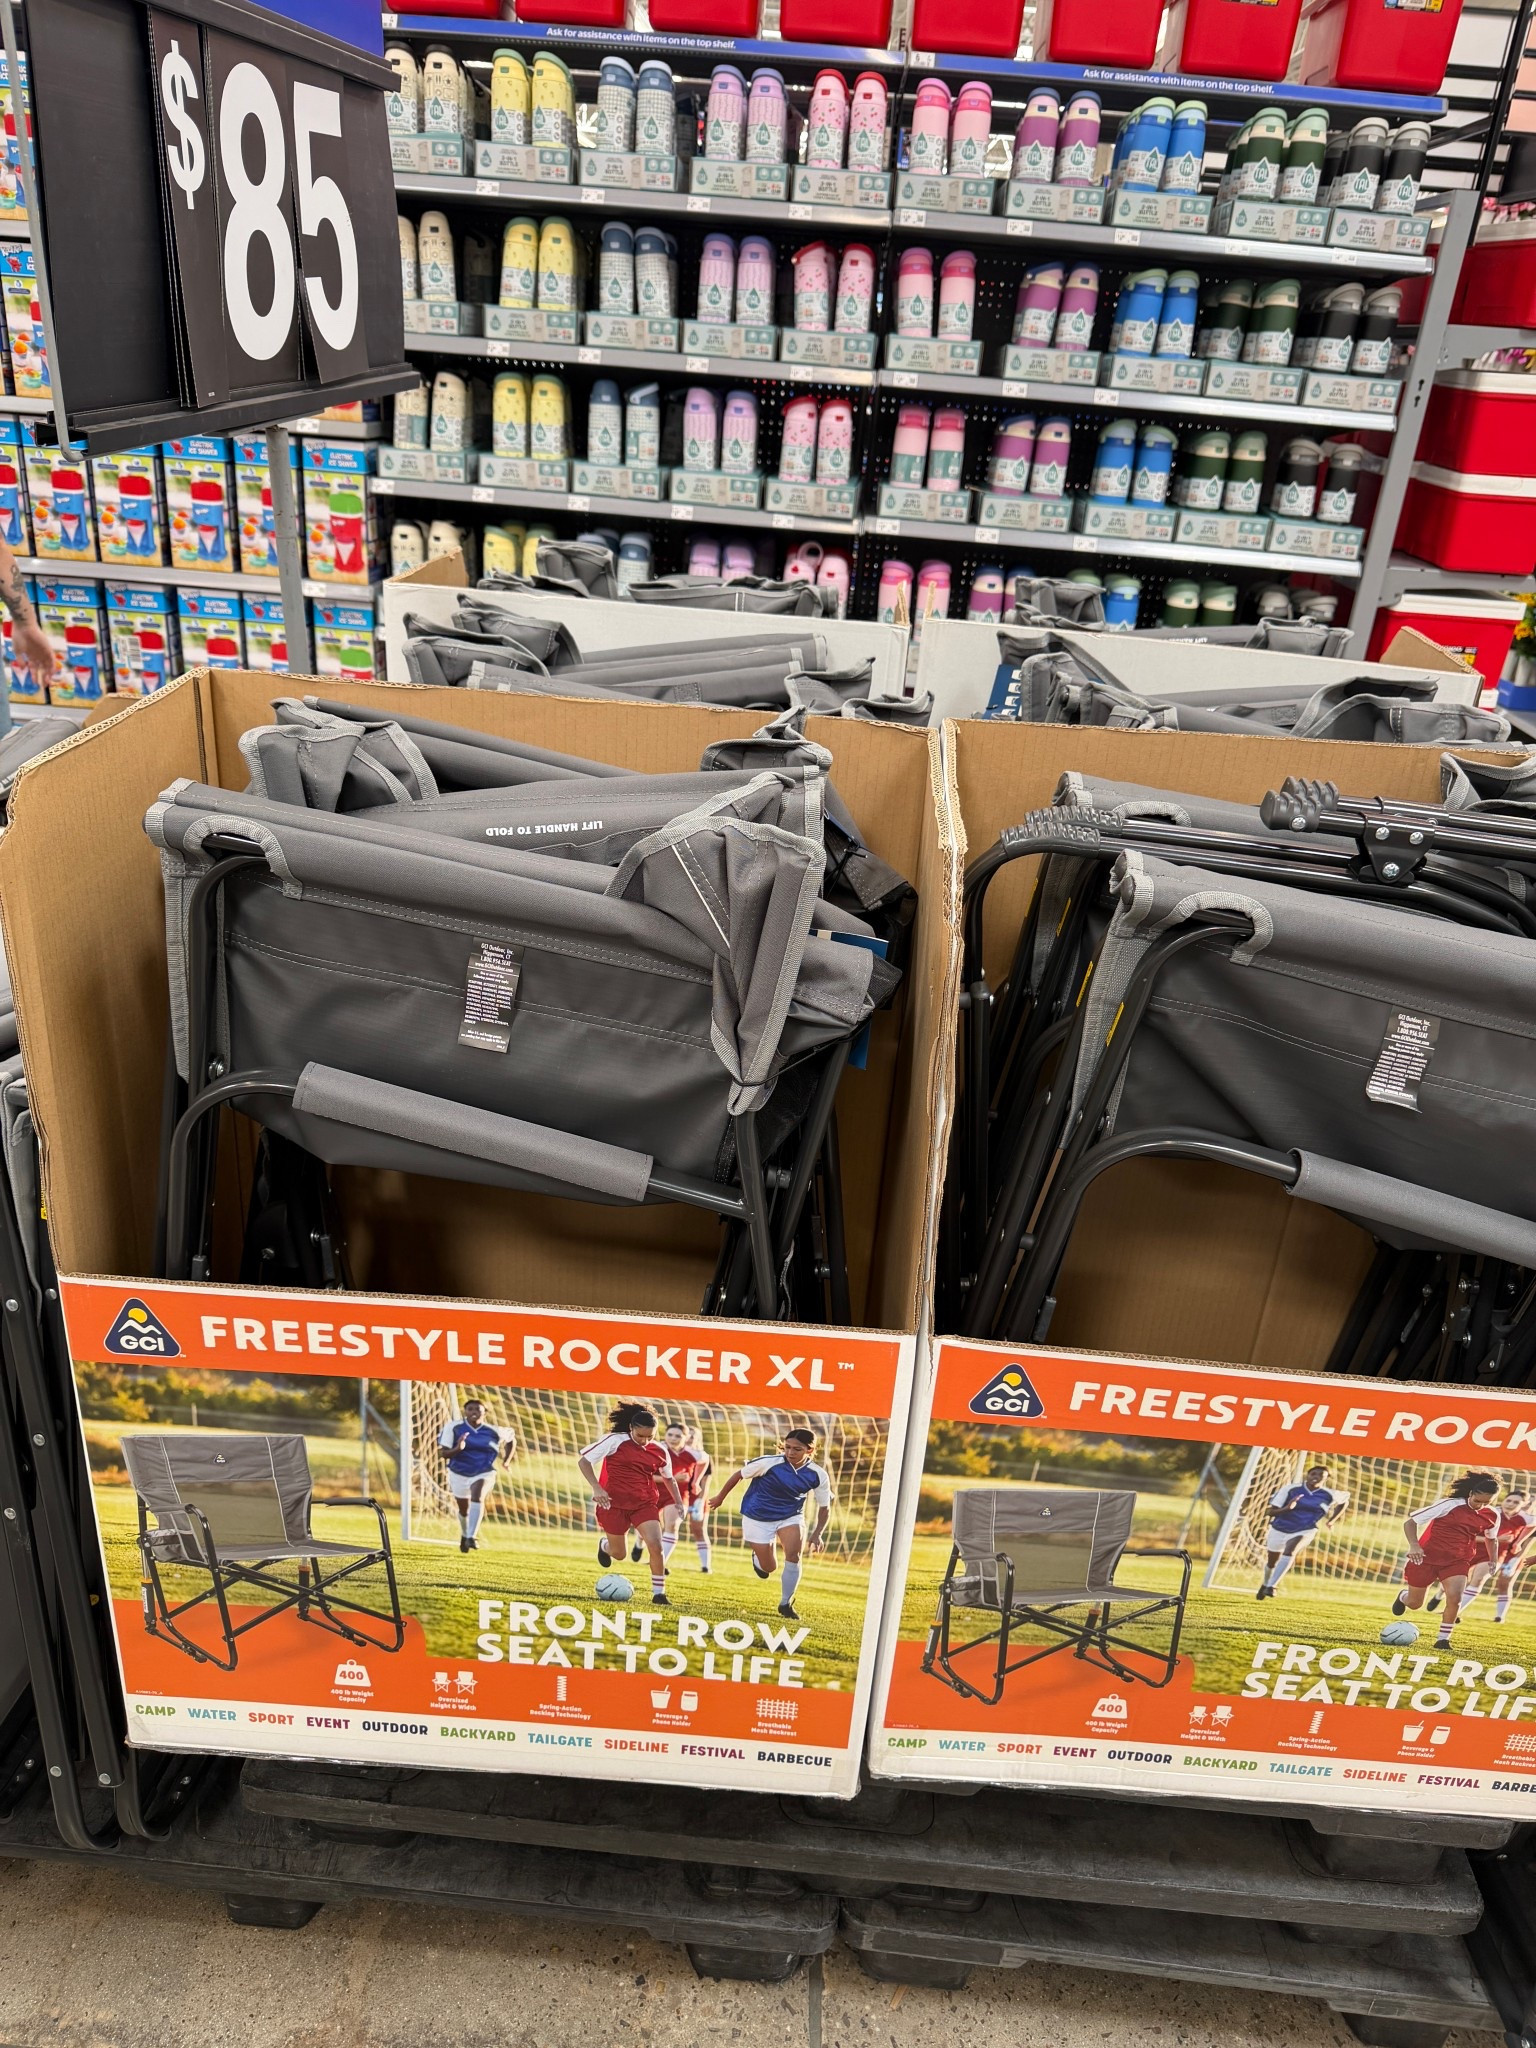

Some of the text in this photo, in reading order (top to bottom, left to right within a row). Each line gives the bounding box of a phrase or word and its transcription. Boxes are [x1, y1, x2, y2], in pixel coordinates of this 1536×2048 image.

[546, 27, 563, 37] Ask
[564, 28, 576, 37] for
[577, 30, 622, 41] assistance
[623, 33, 642, 42] with
[643, 34, 667, 45] items
[680, 36, 695, 46] the
[696, 38, 712, 49] top
[712, 38, 736, 49] shelf.
[1084, 68, 1100, 78] Ask
[1101, 70, 1114, 79] for
[1115, 72, 1159, 84] assistance
[1160, 76, 1180, 86] with
[1181, 77, 1204, 87] items
[1218, 80, 1234, 90] the
[1234, 82, 1250, 92] top
[1250, 82, 1274, 94] shelf.
[161, 40, 358, 361] $85
[486, 820, 603, 836] LIFT HANDLE TO FOLD
[119, 1334, 165, 1352] GCI
[200, 1316, 506, 1366] FREESTYLE
[523, 1335, 751, 1385] ROCKER
[985, 1396, 1030, 1413] GCI
[1069, 1381, 1376, 1438] FREESTYLE
[478, 1600, 811, 1655] FRONT ROW
[476, 1634, 804, 1688] SEAT TO LIFE
[1252, 1642, 1536, 1691] FRONT RO
[339, 1670, 364, 1681] 400
[330, 1688, 344, 1696] 400
[351, 1690, 374, 1698] Weight
[1241, 1672, 1376, 1706] SEAT
[1383, 1683, 1450, 1713] TO
[338, 1696, 366, 1704] Capacity
[437, 1696, 469, 1704] Oversized
[430, 1702, 449, 1711] Height
[458, 1704, 477, 1712] Width
[538, 1702, 582, 1713] Spring-Action
[1098, 1704, 1123, 1713] 400
[529, 1709, 592, 1721] Rocking Technology
[655, 1712, 682, 1721] Beverage
[652, 1718, 692, 1728] Phone Holder
[757, 1721, 792, 1730] Breathable
[1085, 1720, 1098, 1728] 400
[1106, 1721, 1128, 1730] Weight
[136, 1704, 832, 1767] CAMP WATER SPORT EVENT OUTDOOR BACKYARD TAILGATE SIDELINE FESTIVAL BARBECUE
[750, 1726, 798, 1738] Mesh Backrest
[1090, 1726, 1119, 1735] Capacity
[1190, 1728, 1220, 1736] Oversized
[1180, 1733, 1199, 1742] Height
[1288, 1736, 1330, 1745] Spring-Action
[1277, 1741, 1338, 1752] Rocking Technology
[1402, 1745, 1429, 1753] Beverage
[1397, 1750, 1436, 1760] Phone Holder
[888, 1737, 927, 1749] CAMP
[938, 1740, 986, 1752] WATER
[996, 1742, 1042, 1755] SPORT
[1053, 1746, 1097, 1758] EVENT
[1107, 1750, 1172, 1765] OUTDOOR
[1183, 1756, 1258, 1771] BACKYARD
[1269, 1762, 1333, 1778] TAILGATE
[1343, 1768, 1408, 1783] SIDELINE
[1417, 1774, 1481, 1789] FESTIVAL
